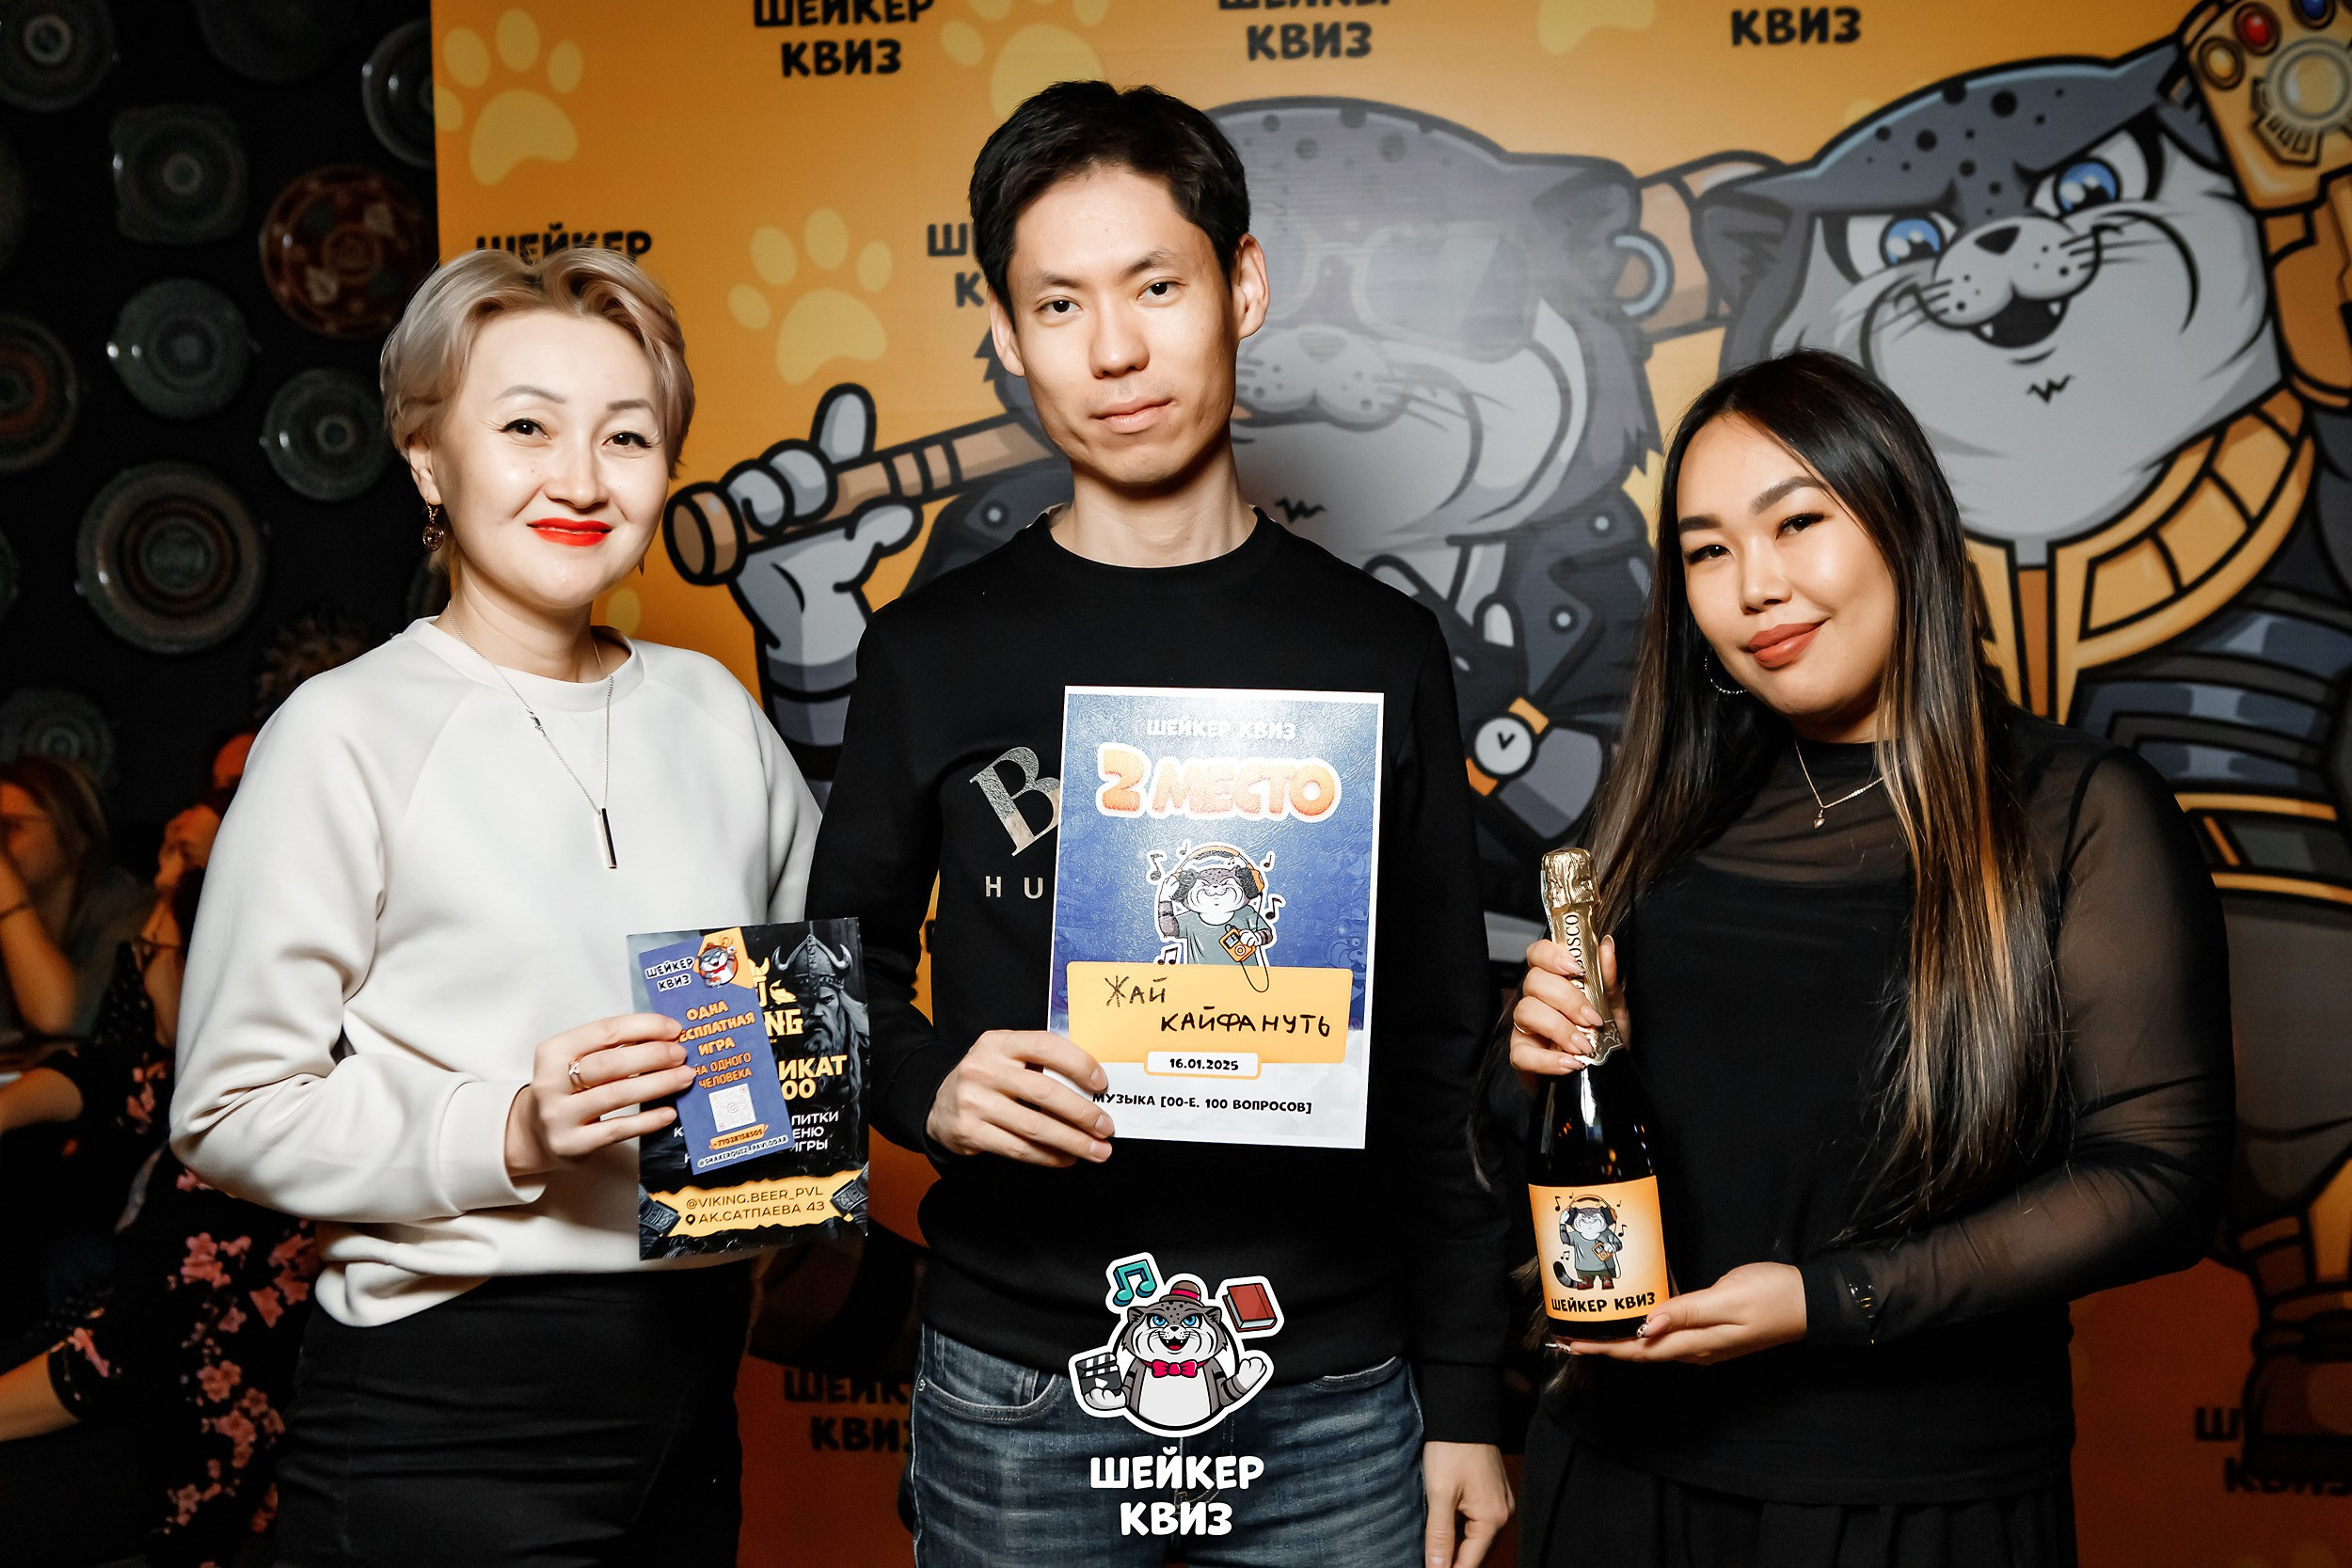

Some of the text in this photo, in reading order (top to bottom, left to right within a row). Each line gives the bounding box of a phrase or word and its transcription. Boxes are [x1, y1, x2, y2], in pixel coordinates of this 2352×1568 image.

[1732, 7, 1861, 46] КВИЗ
[1247, 22, 1372, 60] КВИЗ
[781, 39, 901, 77] КВИЗ
[1147, 718, 1296, 739] ШЕЙКЕР КВИЗ
[1102, 748, 1336, 817] 2 МЕСТО
[985, 876, 1043, 900] HU
[645, 958, 693, 978] ШЕЙКЕР
[658, 974, 691, 991] КВИЗ
[1104, 975, 1167, 1007] ЖАЙ
[686, 1000, 729, 1021] ОДНА
[1161, 1006, 1330, 1037] КАЙФАНУТЬ
[698, 1037, 736, 1056] ИГРА
[709, 1052, 752, 1072] ОДНОГО
[1169, 1058, 1239, 1071] 16.01.2025
[698, 1067, 753, 1088] ЧЕЛОВЕКА
[1092, 1093, 1155, 1106] МУЗЫКА
[1205, 1099, 1228, 1109] 100
[1232, 1101, 1311, 1115] ВОПРОСОВ]
[792, 1126, 825, 1140] ЕНЮ
[686, 1186, 823, 1210] @VIKING.BEER_PVL
[699, 1201, 825, 1224] АК.САТПАЕВА 43
[1551, 1291, 1656, 1312] ШЕЙКЕР КВИЗ
[811, 1417, 910, 1452] КВИ
